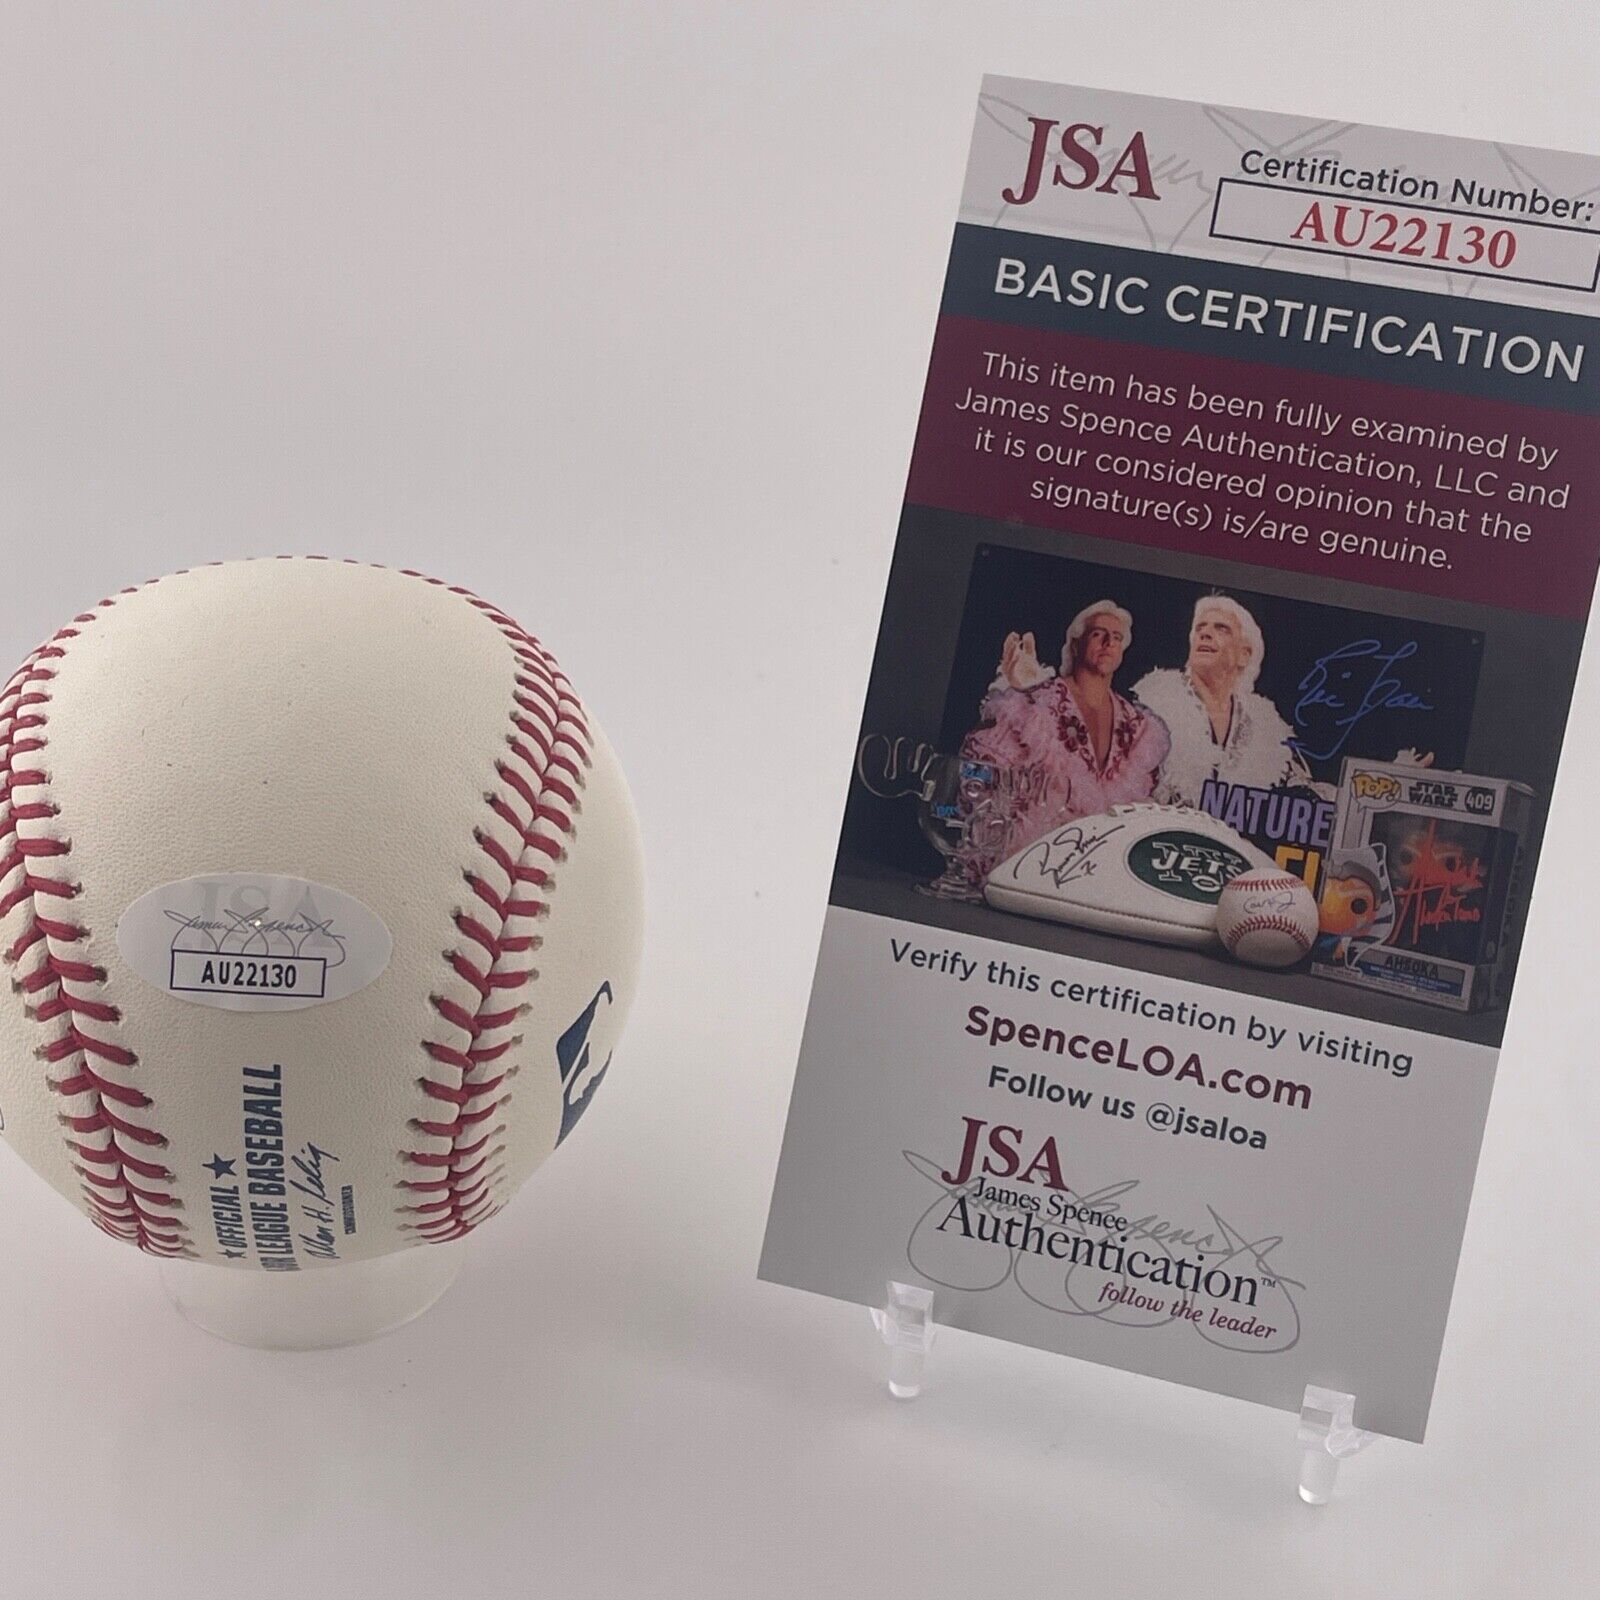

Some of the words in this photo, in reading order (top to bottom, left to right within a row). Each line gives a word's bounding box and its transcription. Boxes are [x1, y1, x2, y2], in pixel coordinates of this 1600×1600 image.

[1002, 117, 1161, 205] JSA
[1240, 150, 1440, 200] Certification
[1451, 178, 1594, 222] Number:
[1291, 200, 1517, 270] AU22130
[994, 258, 1149, 316] BASIC
[1165, 284, 1586, 382] CERTIFICATION
[983, 351, 1040, 385] This
[1050, 363, 1116, 396] item
[1126, 375, 1177, 407] has
[1188, 384, 1264, 420] been
[1274, 399, 1342, 436] fully
[1350, 415, 1508, 459] examined
[1518, 435, 1559, 470] by
[955, 387, 1049, 426] James
[1060, 403, 1171, 444] Spence
[1181, 425, 1422, 489] Authentication,
[1434, 468, 1498, 497] LLC
[1507, 479, 1571, 511] and
[974, 427, 993, 454] it
[1003, 431, 1026, 459] is
[1036, 442, 1087, 469] our
[1095, 450, 1265, 499] considered
[1275, 480, 1396, 517] opinion
[1405, 500, 1468, 533] that
[1481, 512, 1532, 544] the
[1030, 476, 1213, 533] signature(s)
[1223, 507, 1311, 545] is/are
[1319, 527, 1453, 570] genuine.
[1201, 781, 1336, 848] NATURE
[1351, 774, 1401, 799] POP!
[1467, 793, 1493, 810] 409
[1151, 851, 1242, 879] JETS
[201, 960, 297, 988] AU22130
[890, 938, 978, 982] Verify
[987, 961, 1040, 993] this
[1050, 976, 1237, 1036] certification
[1248, 1015, 1287, 1050] by
[1298, 1030, 1414, 1077] visiting
[965, 1004, 1313, 1110] SpenceLOA.com
[243, 1064, 286, 1196] BASEBALL
[988, 1064, 1093, 1110] Follow
[1102, 1093, 1135, 1119] us
[1145, 1102, 1268, 1149] @jsaloa
[941, 1116, 1069, 1191] JSA
[209, 1186, 247, 1248] OFFICIAL
[250, 1202, 294, 1254] LEAGUE
[973, 1176, 1041, 1211] James
[1098, 1282, 1164, 1313] follow
[1170, 1300, 1203, 1323] the
[1209, 1307, 1277, 1340] leader
